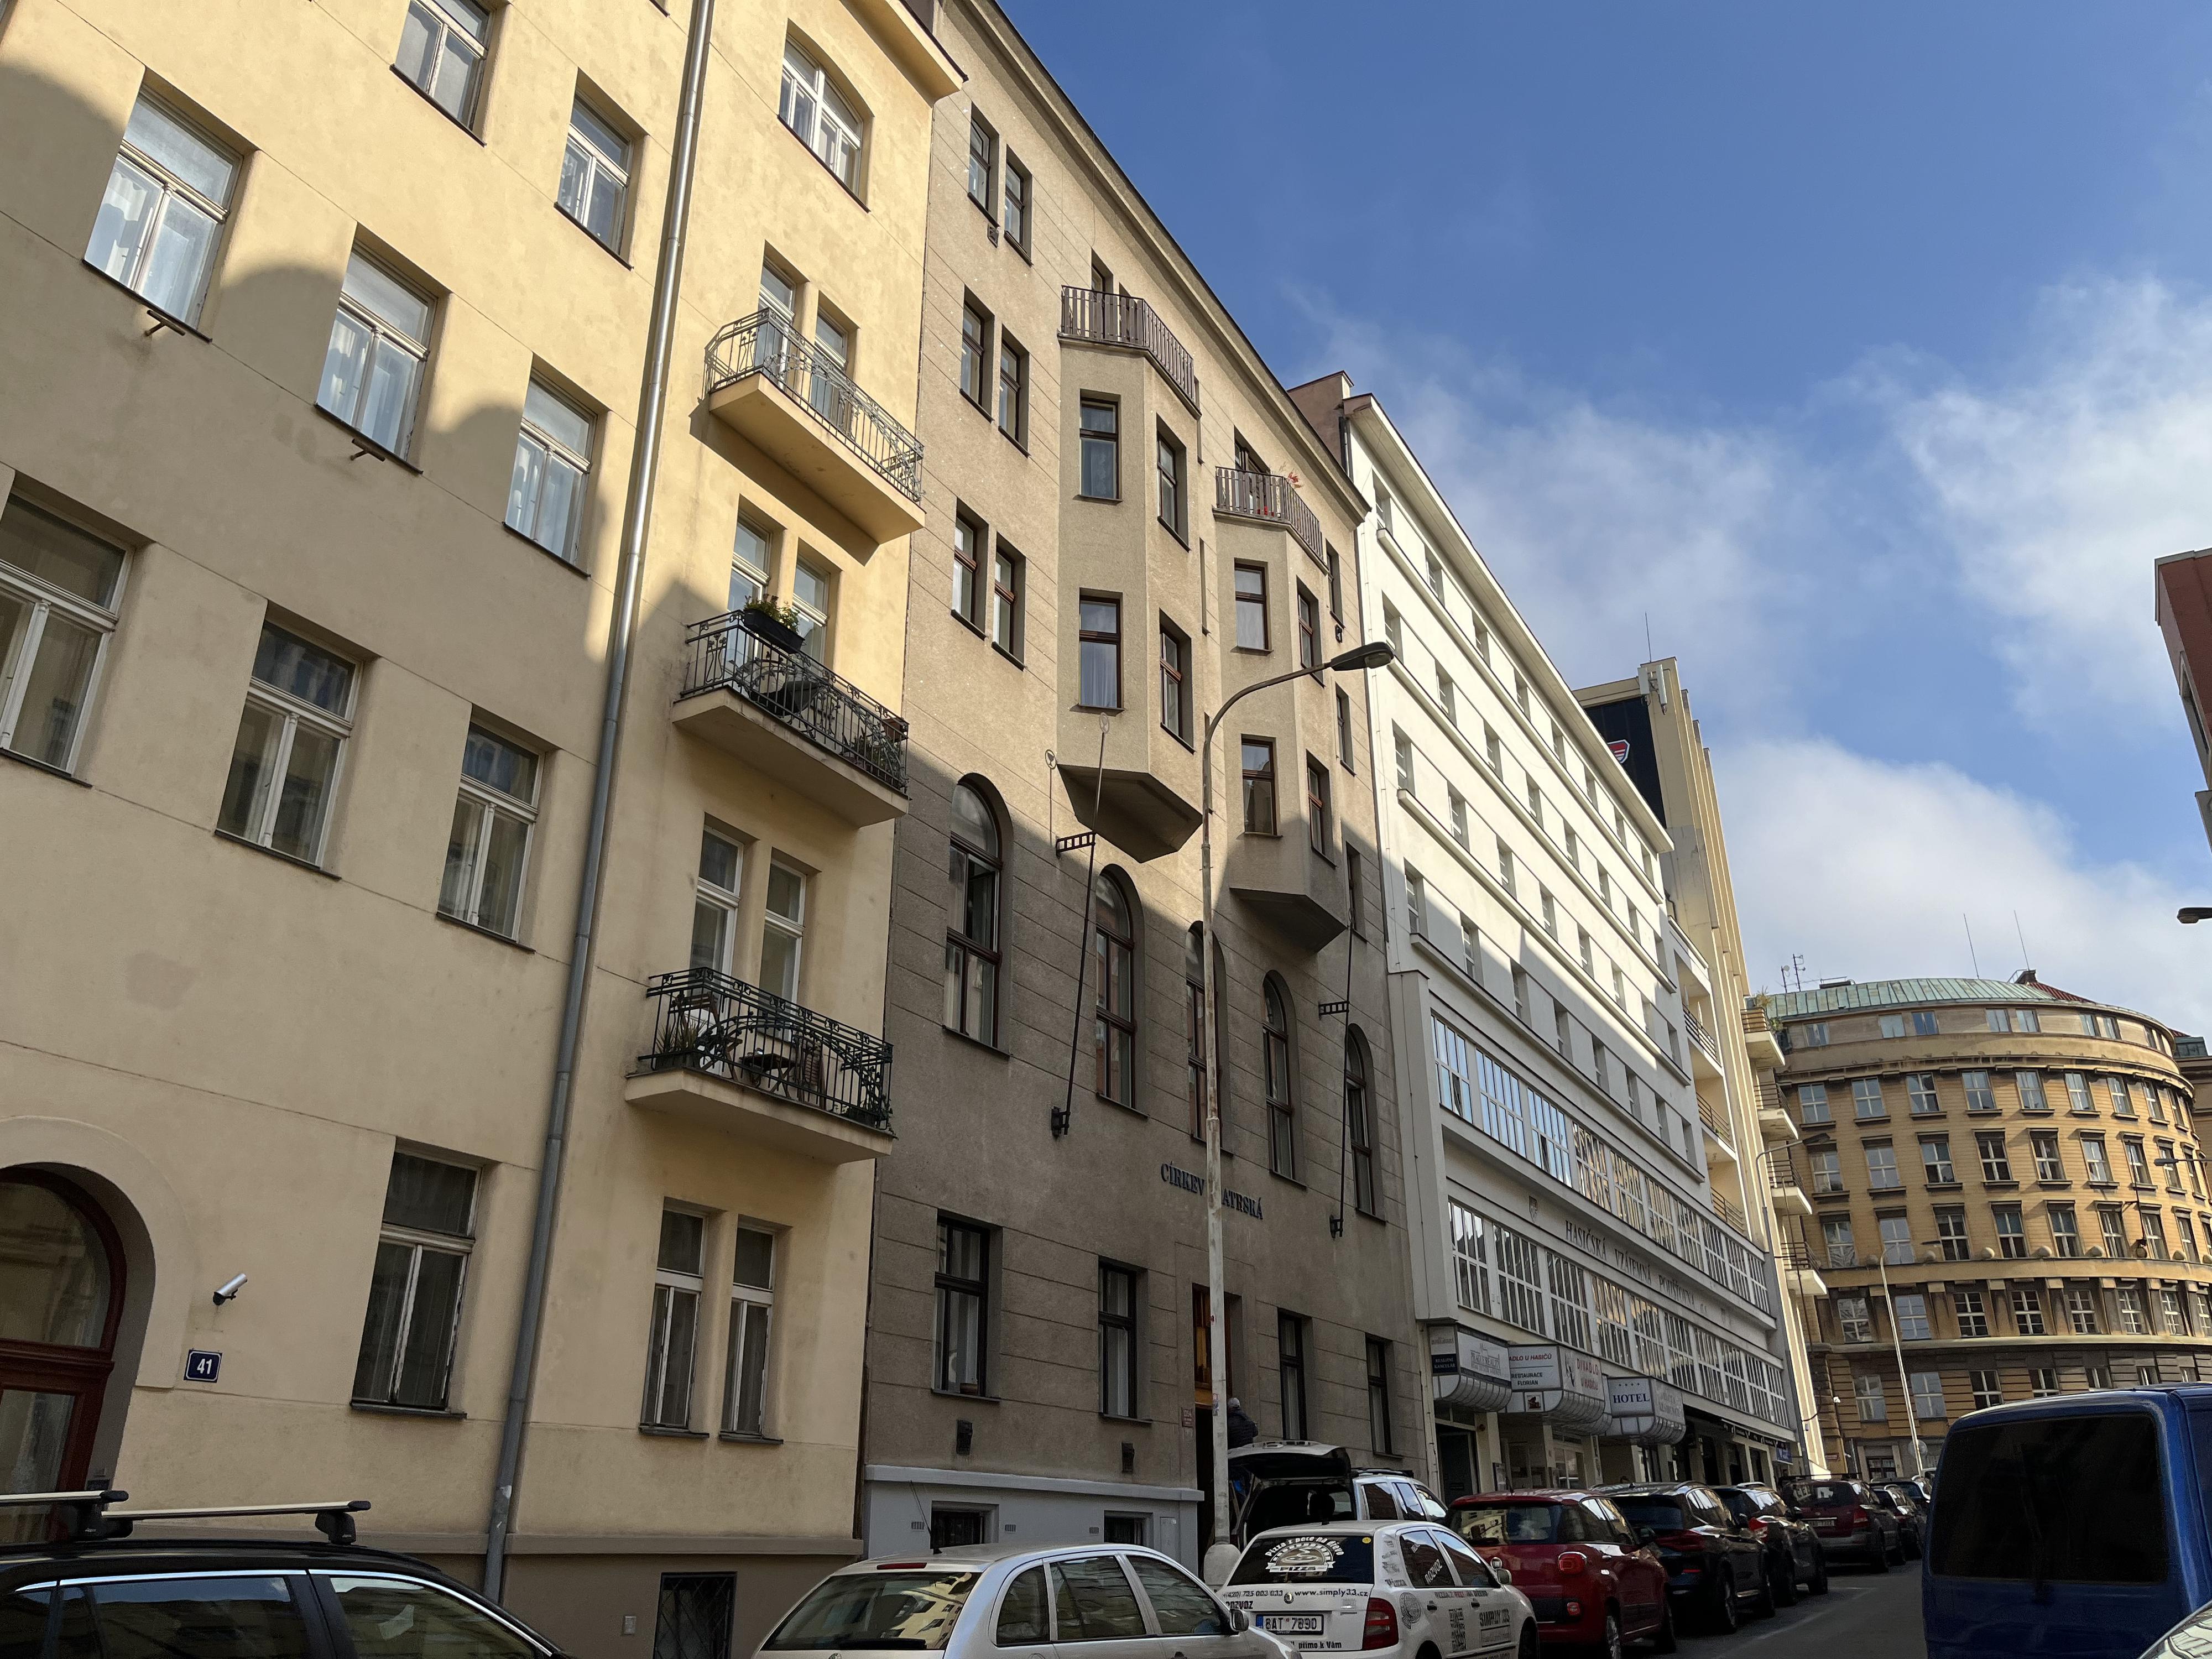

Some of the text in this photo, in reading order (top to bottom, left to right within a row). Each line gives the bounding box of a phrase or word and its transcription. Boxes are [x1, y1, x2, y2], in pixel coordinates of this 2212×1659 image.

[1161, 1161, 1264, 1220] CÍRKEV ATRSKÁ
[1566, 1220, 1607, 1261] HASIČSKÁ
[197, 1358, 212, 1375] 41
[1577, 1358, 1599, 1375] DIVADLO
[1613, 1393, 1650, 1404] HOTEL
[1294, 1588, 1368, 1598] www.simply33.cz
[1265, 1618, 1317, 1630] 8AT 7890
[1479, 1610, 1501, 1627] SIMPLY
